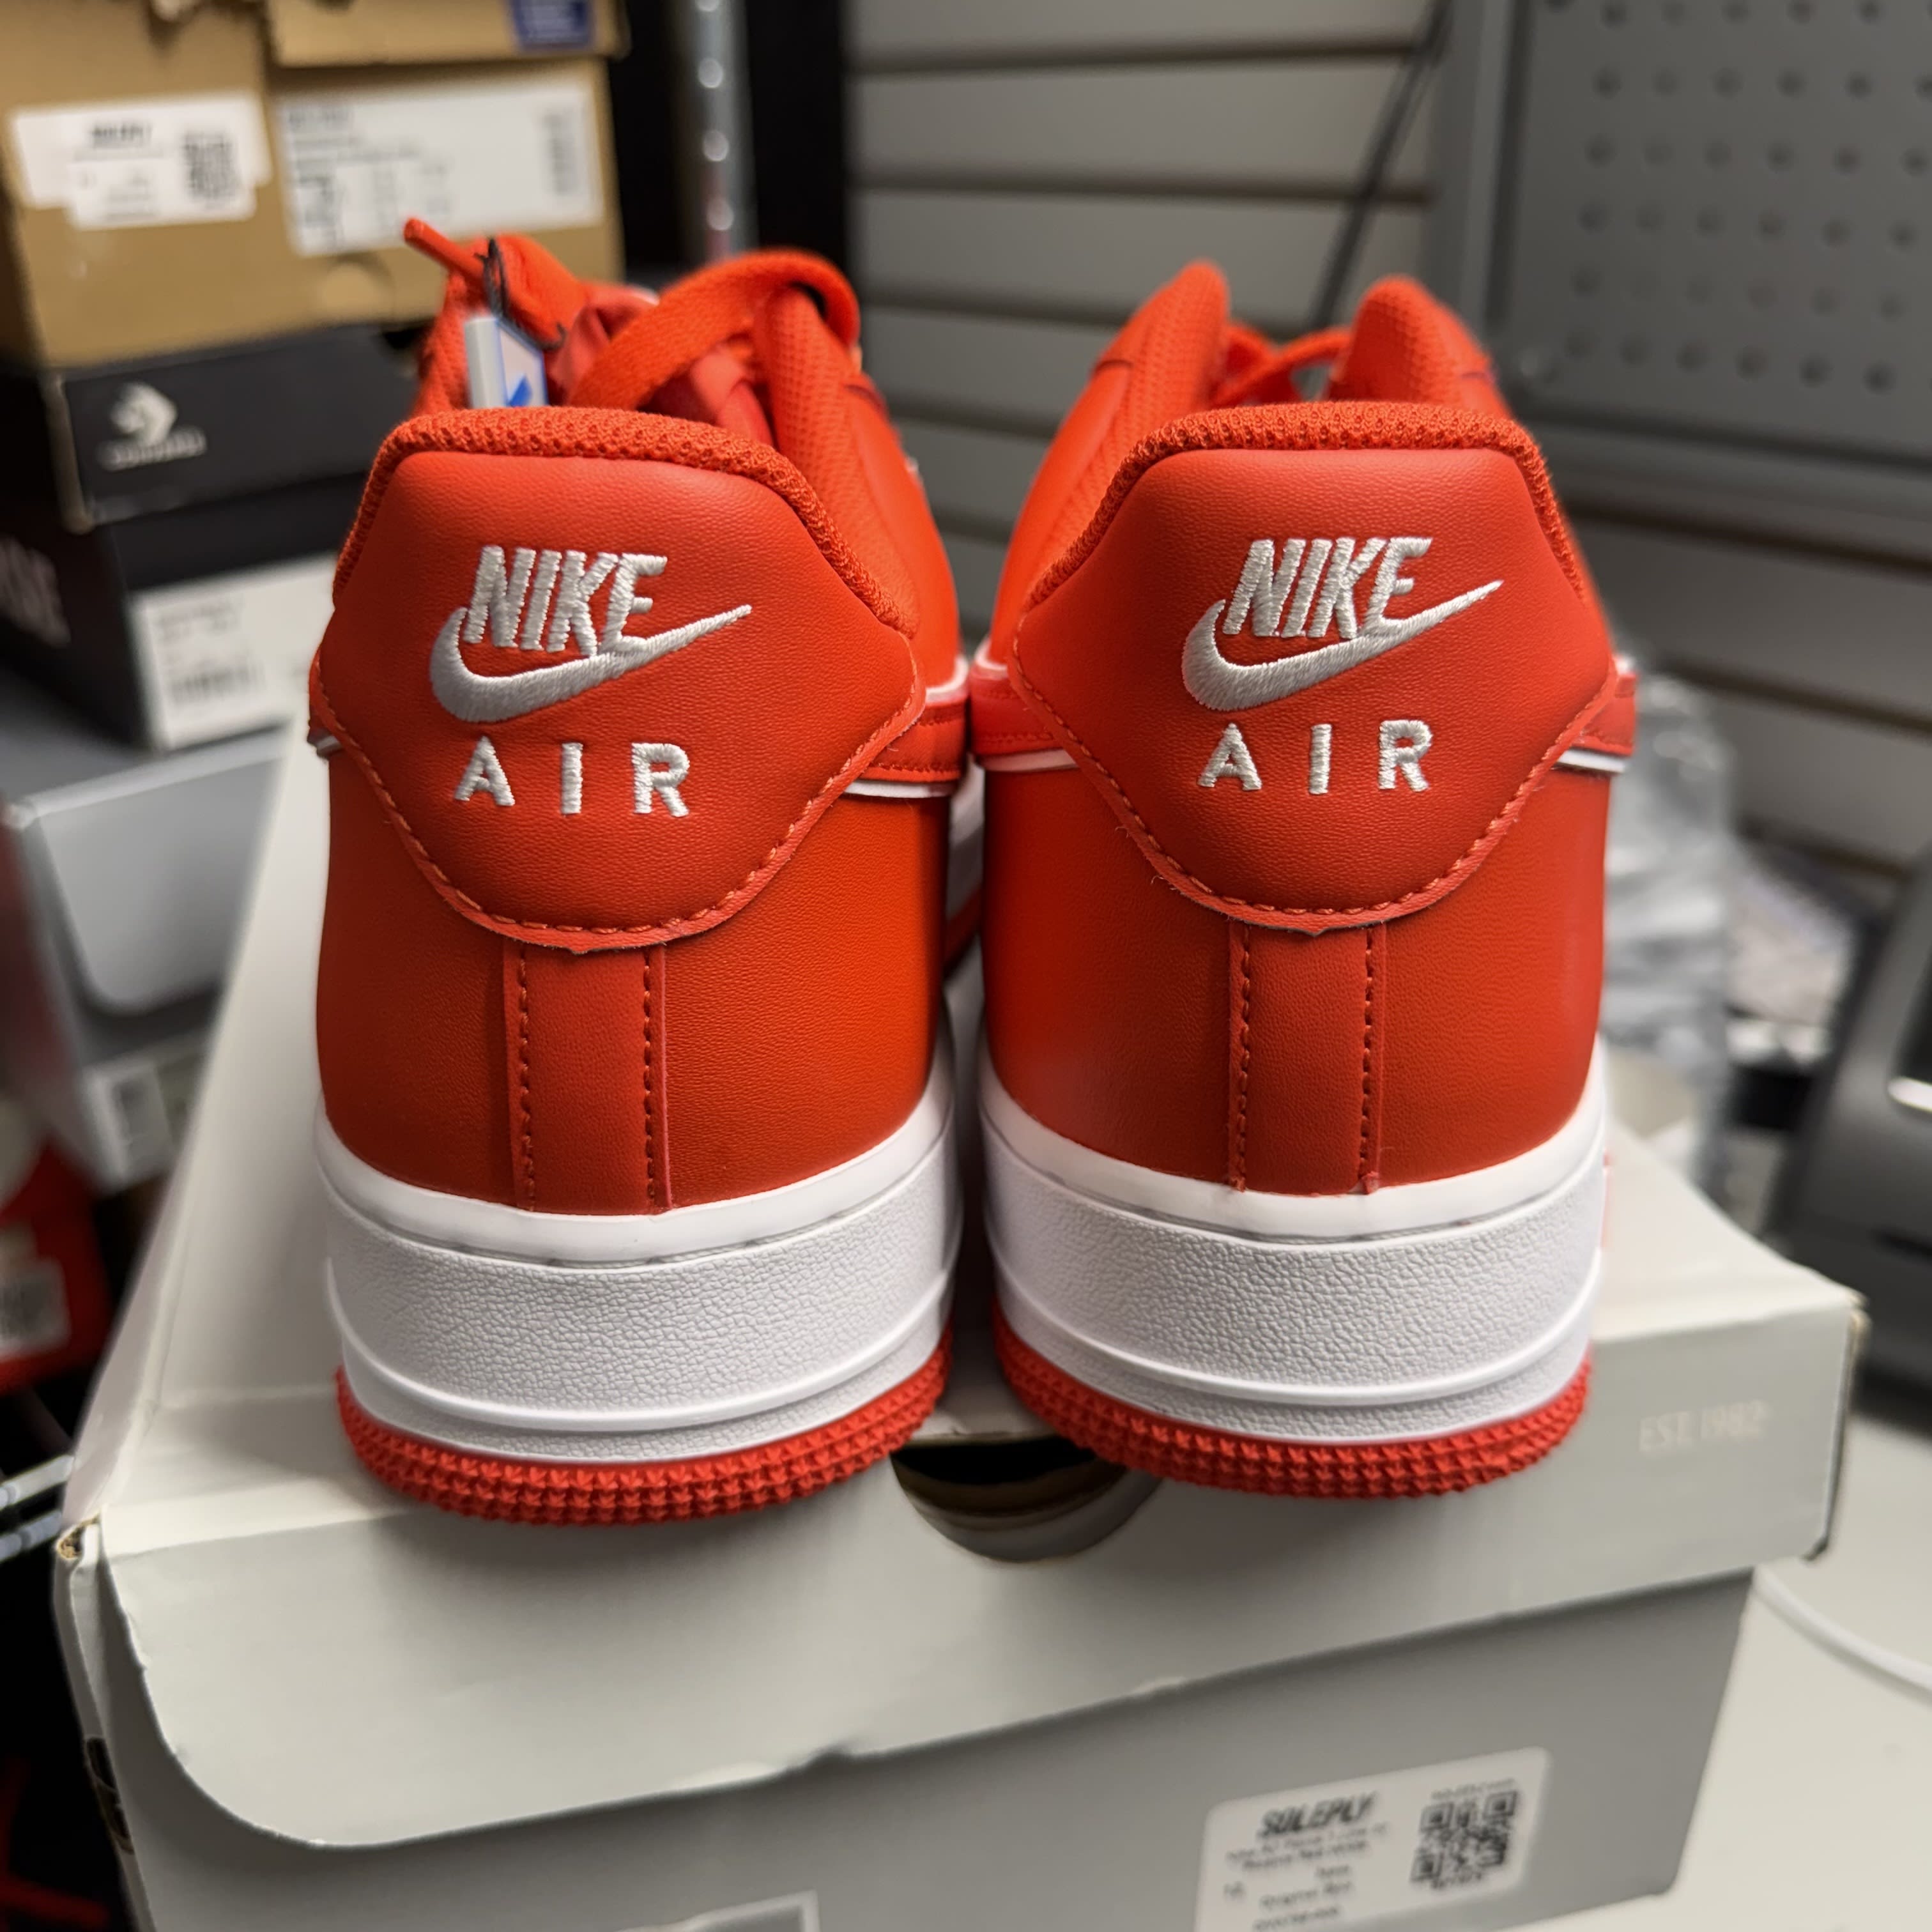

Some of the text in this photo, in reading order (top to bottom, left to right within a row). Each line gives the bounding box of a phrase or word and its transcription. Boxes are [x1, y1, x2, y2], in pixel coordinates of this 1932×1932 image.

[463, 544, 668, 656] NIKE
[1222, 536, 1434, 640] NIKE
[454, 735, 690, 817] AIR
[1197, 719, 1433, 795] AIR
